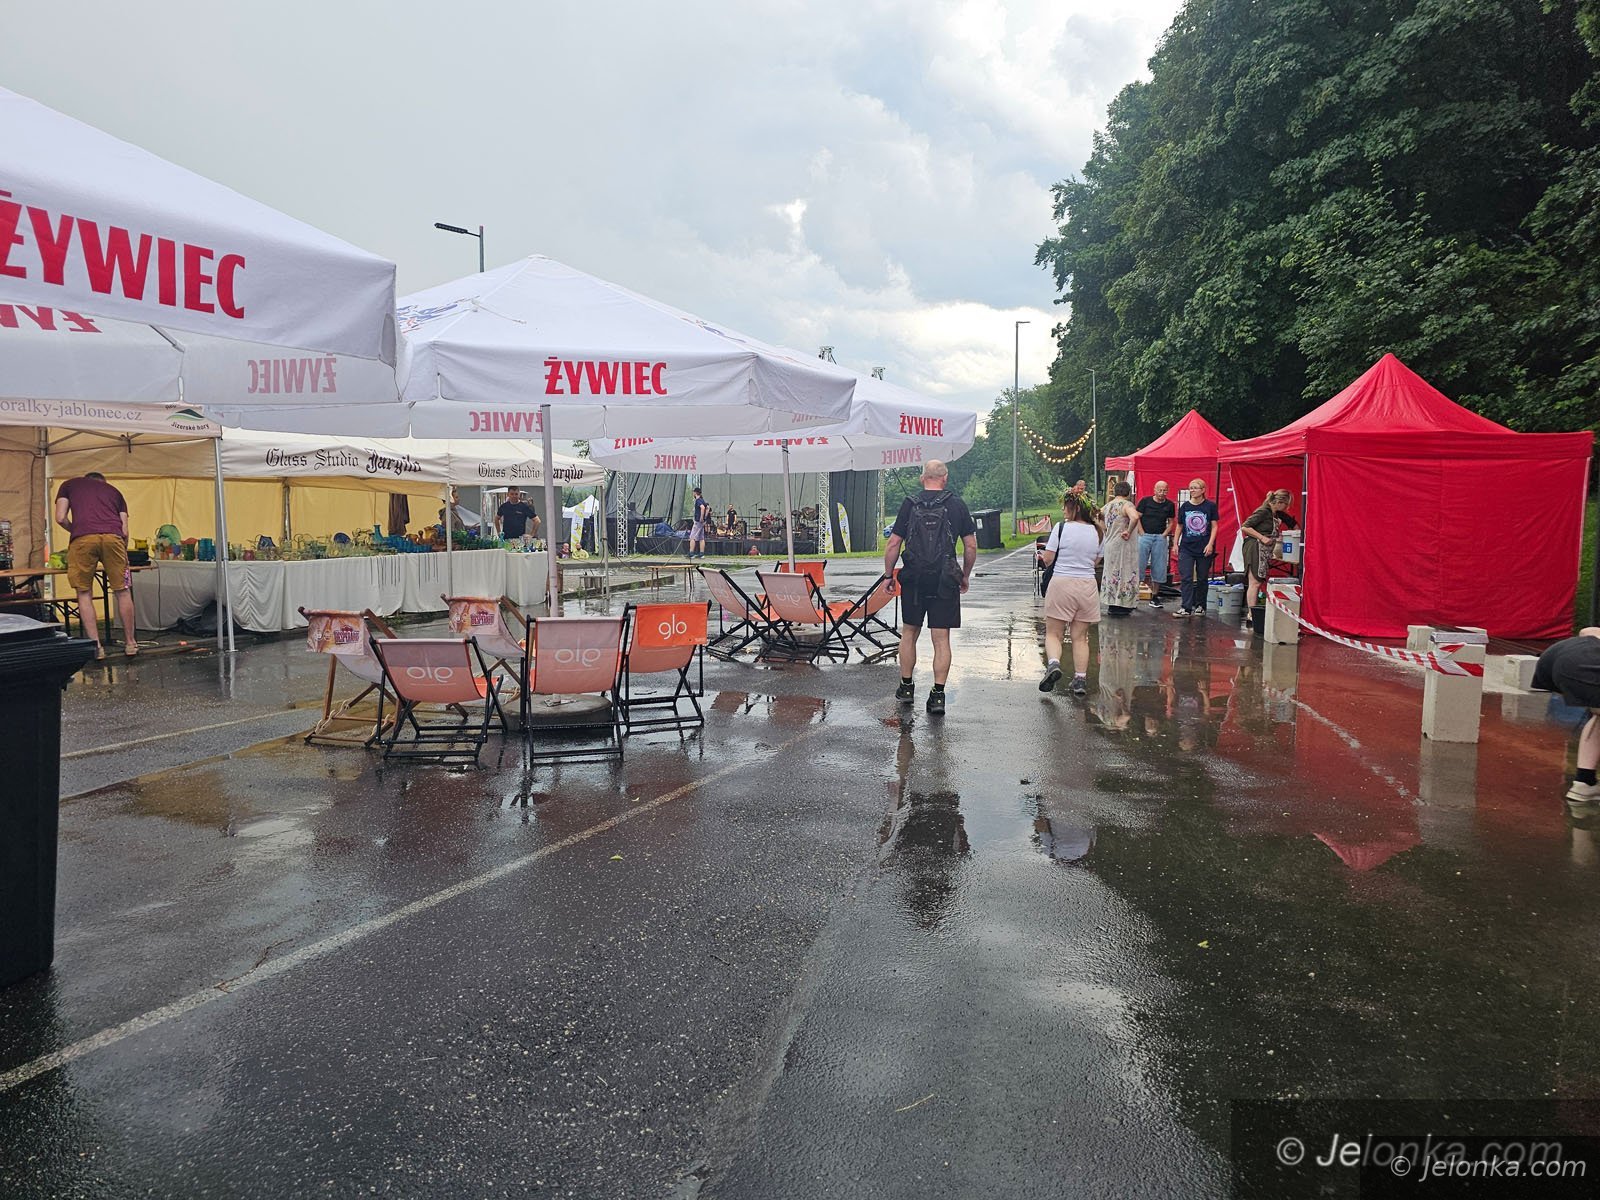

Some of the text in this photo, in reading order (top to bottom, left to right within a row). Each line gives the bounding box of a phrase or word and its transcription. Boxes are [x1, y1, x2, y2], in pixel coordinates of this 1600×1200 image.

[543, 356, 667, 395] ŻYWIEC
[900, 412, 943, 437] ŻYWIEC
[266, 448, 307, 467] Glass
[314, 449, 359, 470] Studio
[478, 462, 583, 483] Glass Studio argilo
[658, 613, 687, 640] glo
